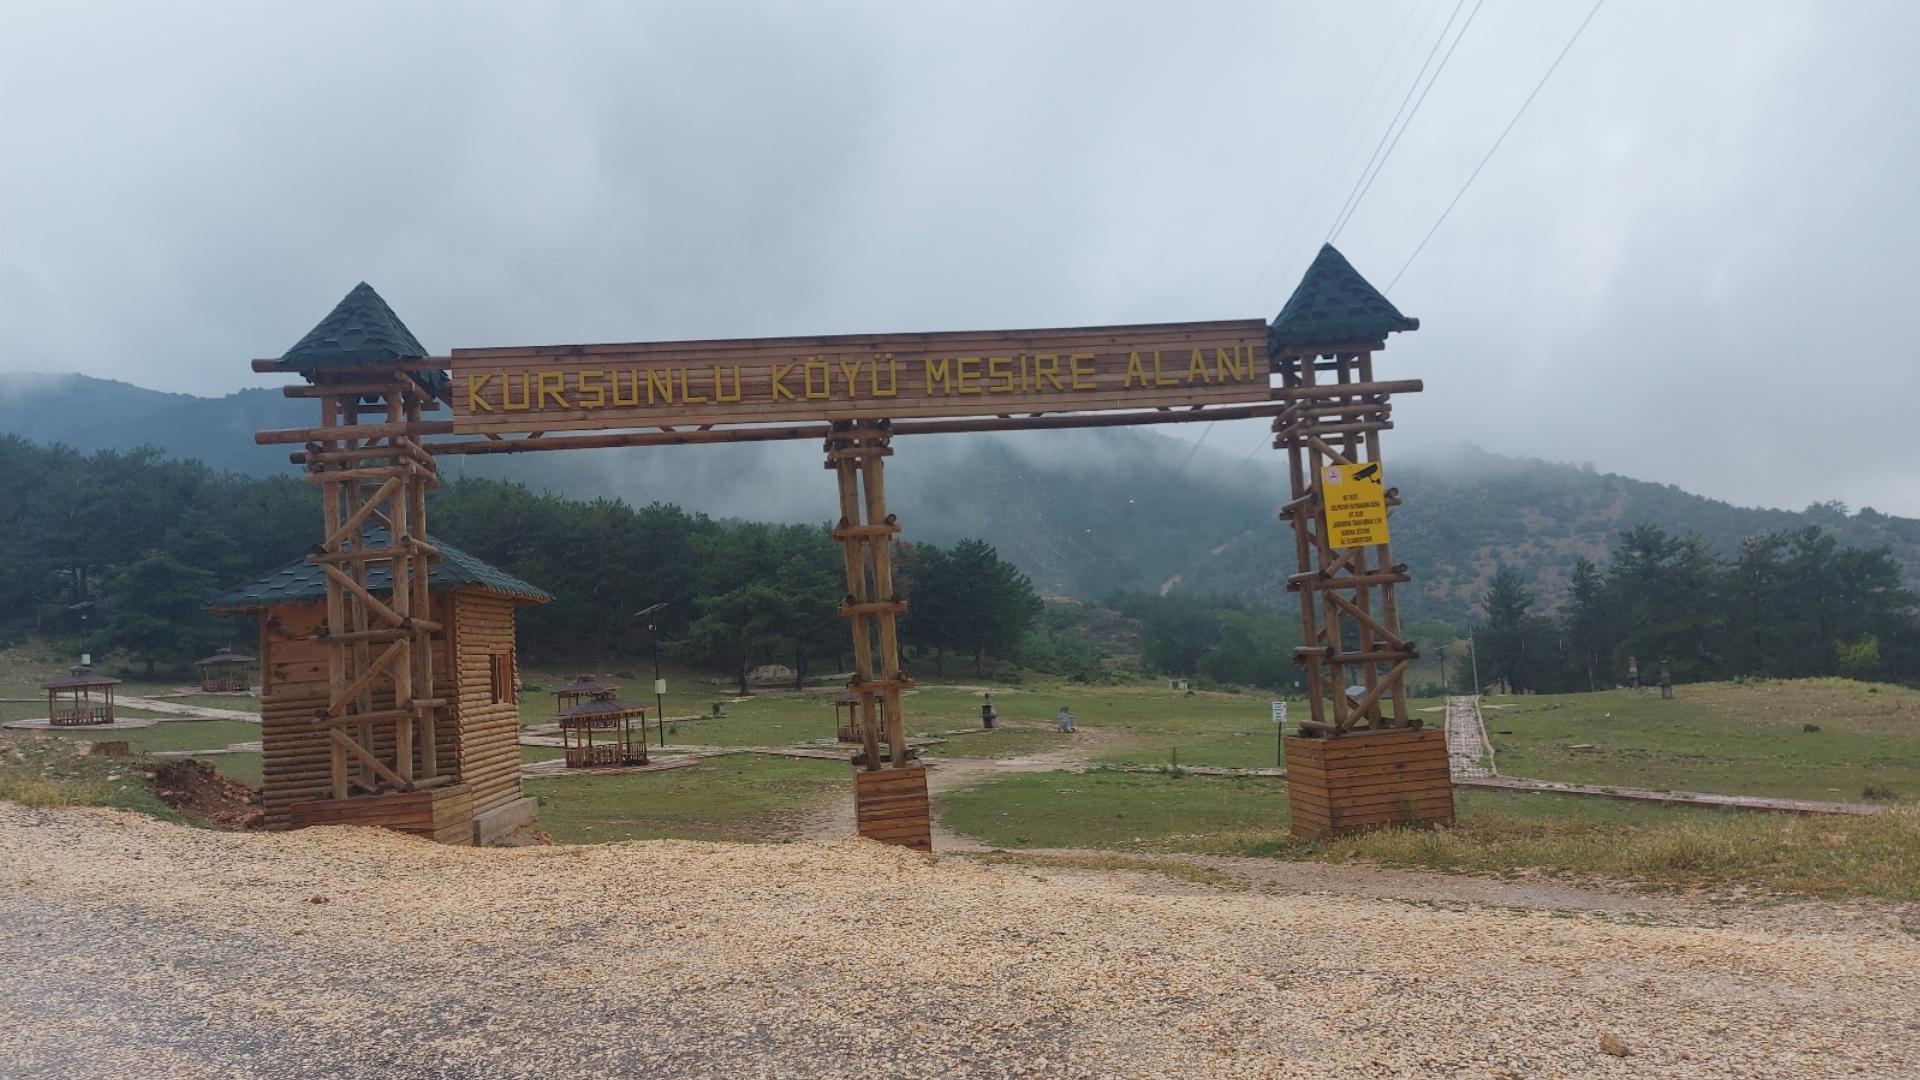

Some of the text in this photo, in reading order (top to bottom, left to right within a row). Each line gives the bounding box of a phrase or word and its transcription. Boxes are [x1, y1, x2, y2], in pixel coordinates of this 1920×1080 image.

[468, 340, 1255, 412] KURŞUNLU KÖYÜ MESİRE ALANI
